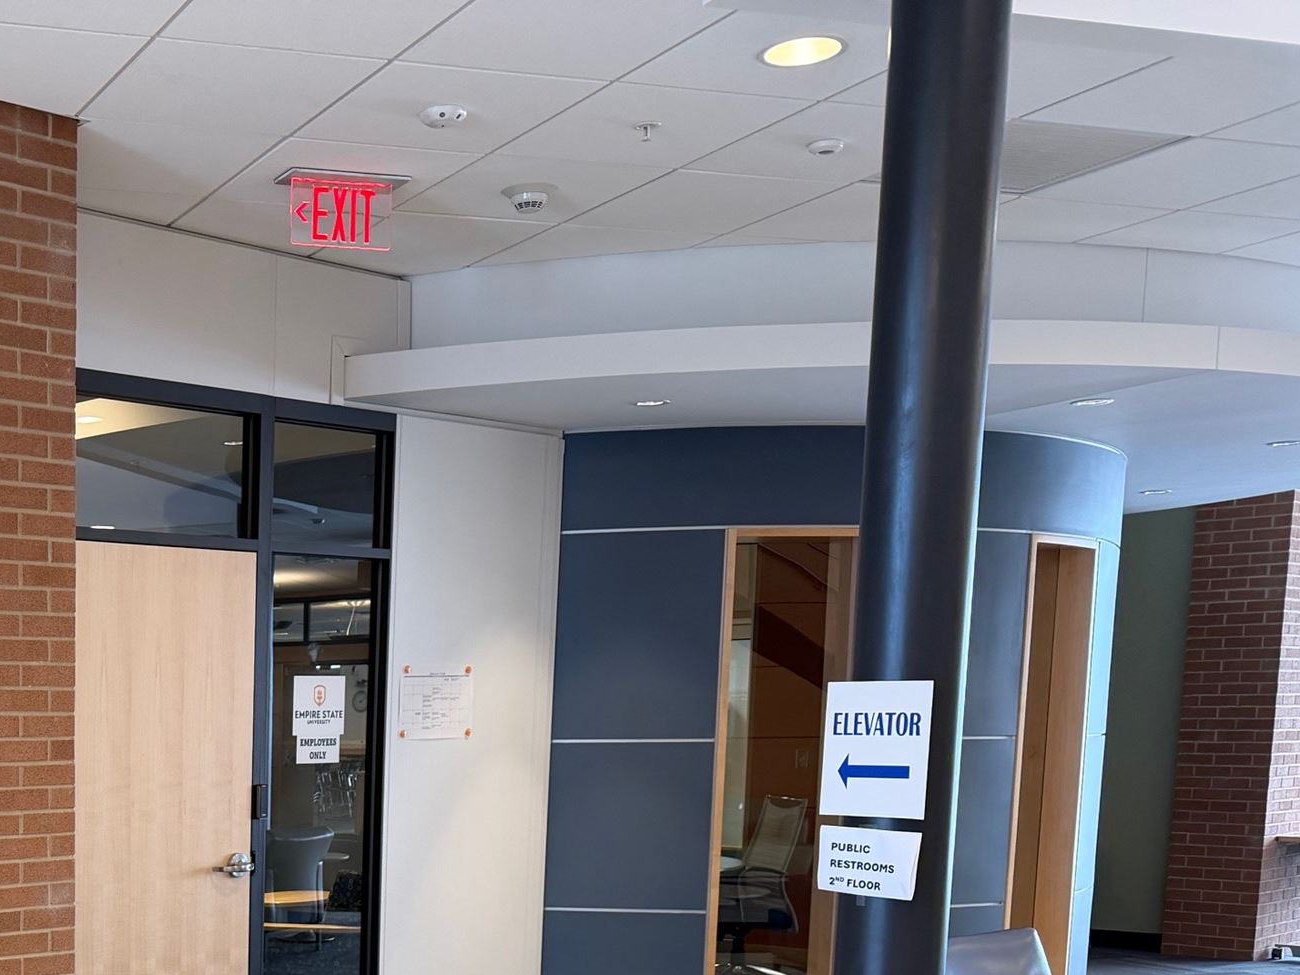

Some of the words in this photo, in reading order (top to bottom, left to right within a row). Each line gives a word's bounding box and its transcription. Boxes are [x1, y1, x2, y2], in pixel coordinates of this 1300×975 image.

[312, 186, 376, 244] EXIT
[295, 710, 321, 719] EMPIRE
[322, 710, 343, 719] STATE
[833, 712, 922, 736] ELEVATOR
[300, 738, 337, 747] EMPLOYEES
[309, 751, 327, 760] ONLY
[831, 842, 871, 854] PUBLIC
[829, 859, 895, 874] RESTROOMS
[829, 877, 845, 886] 2ND
[846, 878, 881, 891] FLOOR
